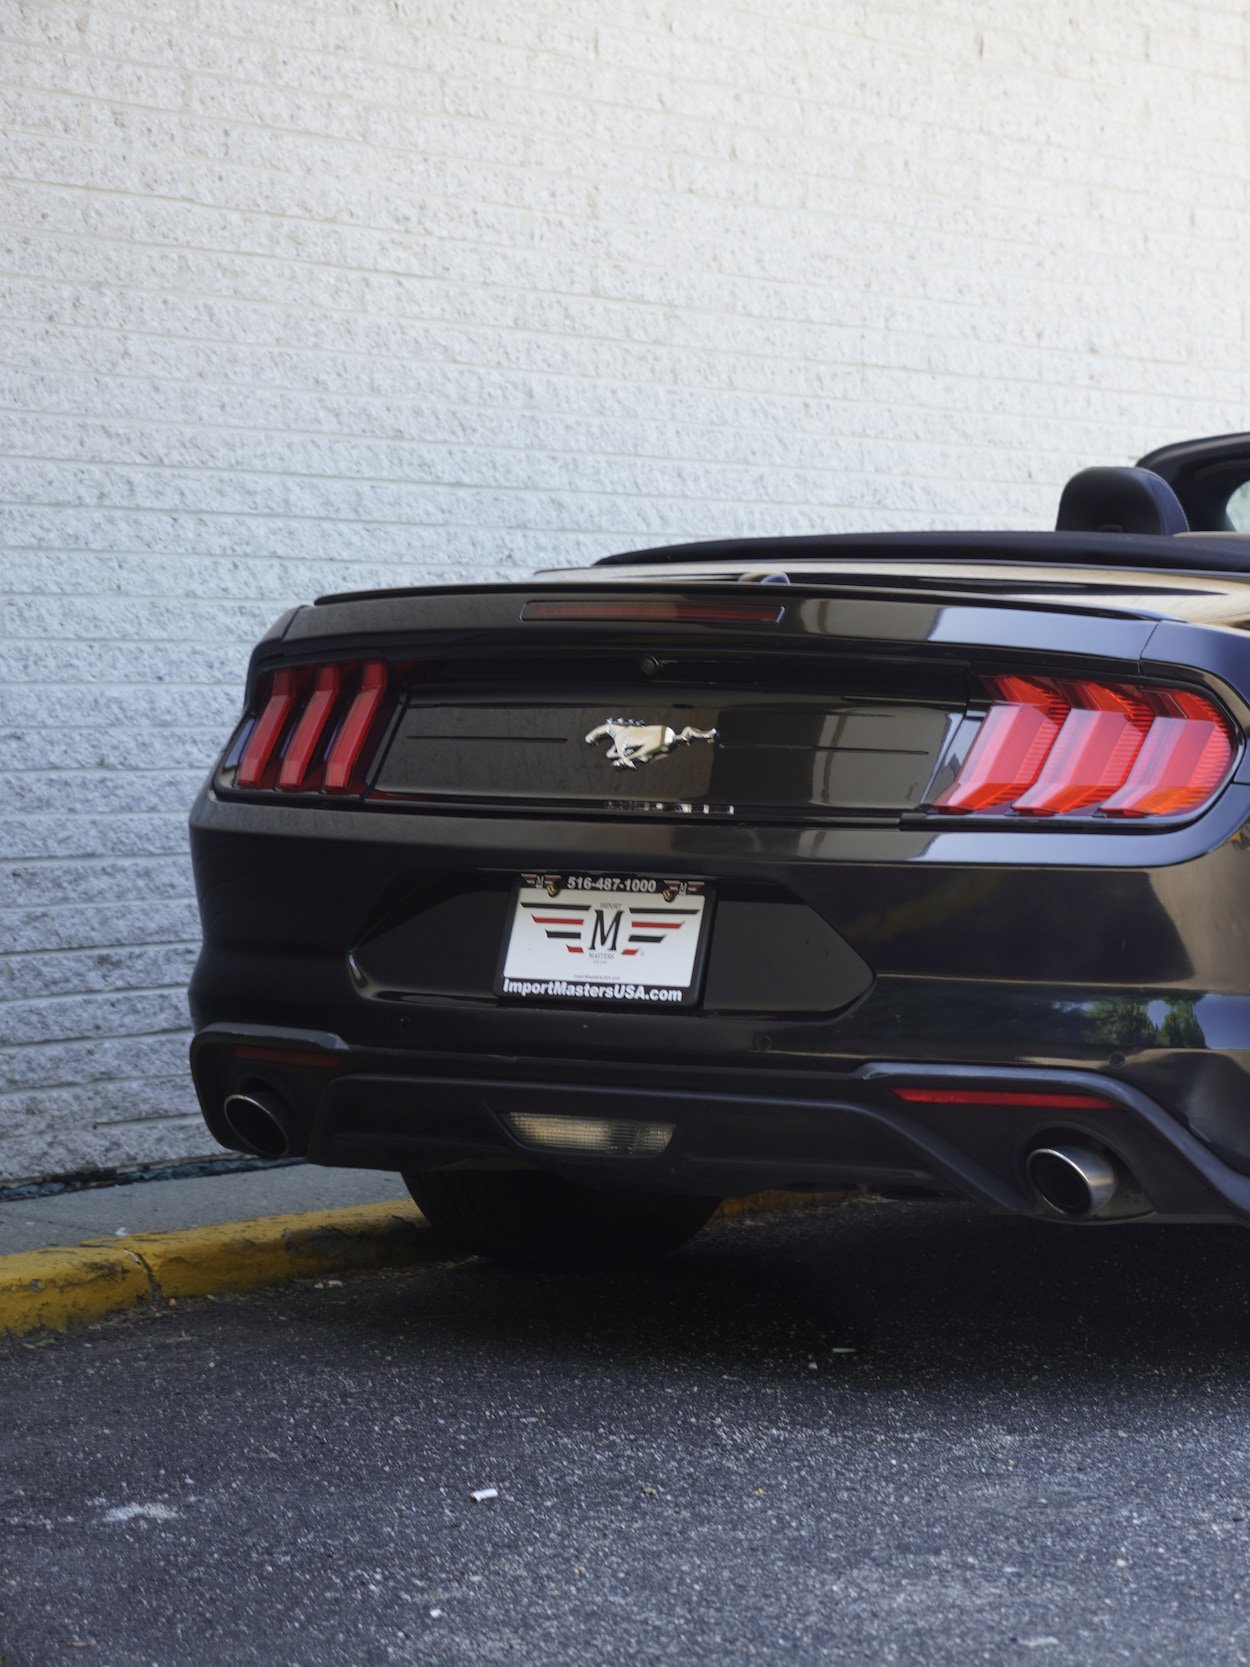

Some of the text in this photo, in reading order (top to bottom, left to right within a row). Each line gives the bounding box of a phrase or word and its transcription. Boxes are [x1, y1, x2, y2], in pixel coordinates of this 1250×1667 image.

[567, 876, 657, 893] 516-487-1000
[588, 909, 624, 951] M
[503, 978, 683, 1002] ImportMastersUSA.com
